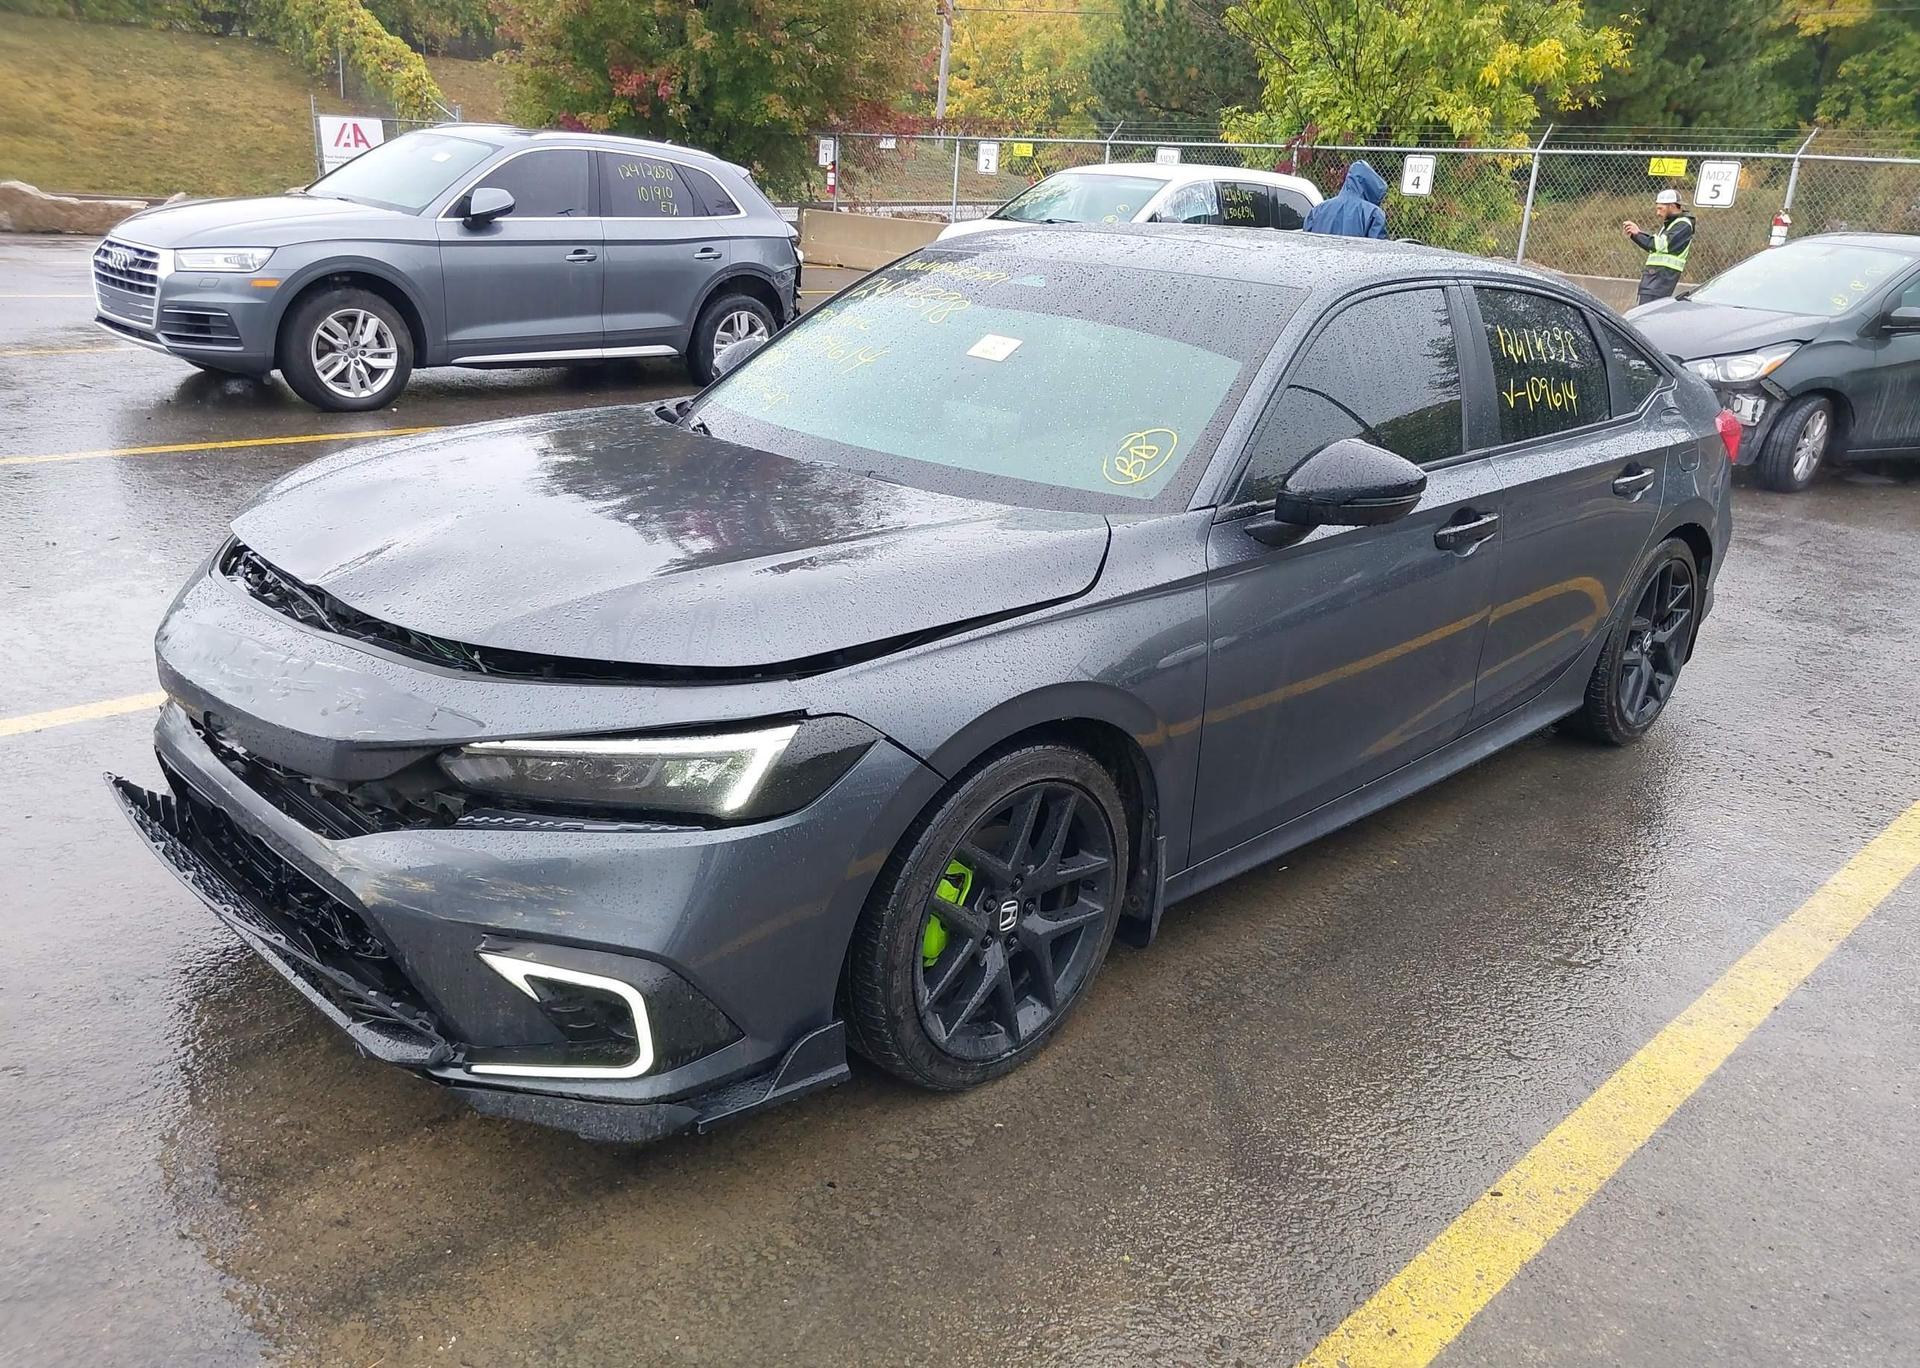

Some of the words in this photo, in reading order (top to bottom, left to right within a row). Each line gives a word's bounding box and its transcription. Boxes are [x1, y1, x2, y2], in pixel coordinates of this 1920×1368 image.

[984, 158, 991, 170] 2
[1408, 163, 1429, 174] MDZ
[1706, 170, 1732, 182] MDZ
[1411, 176, 1421, 190] 4
[637, 186, 673, 202] 101910
[1709, 184, 1722, 200] 5
